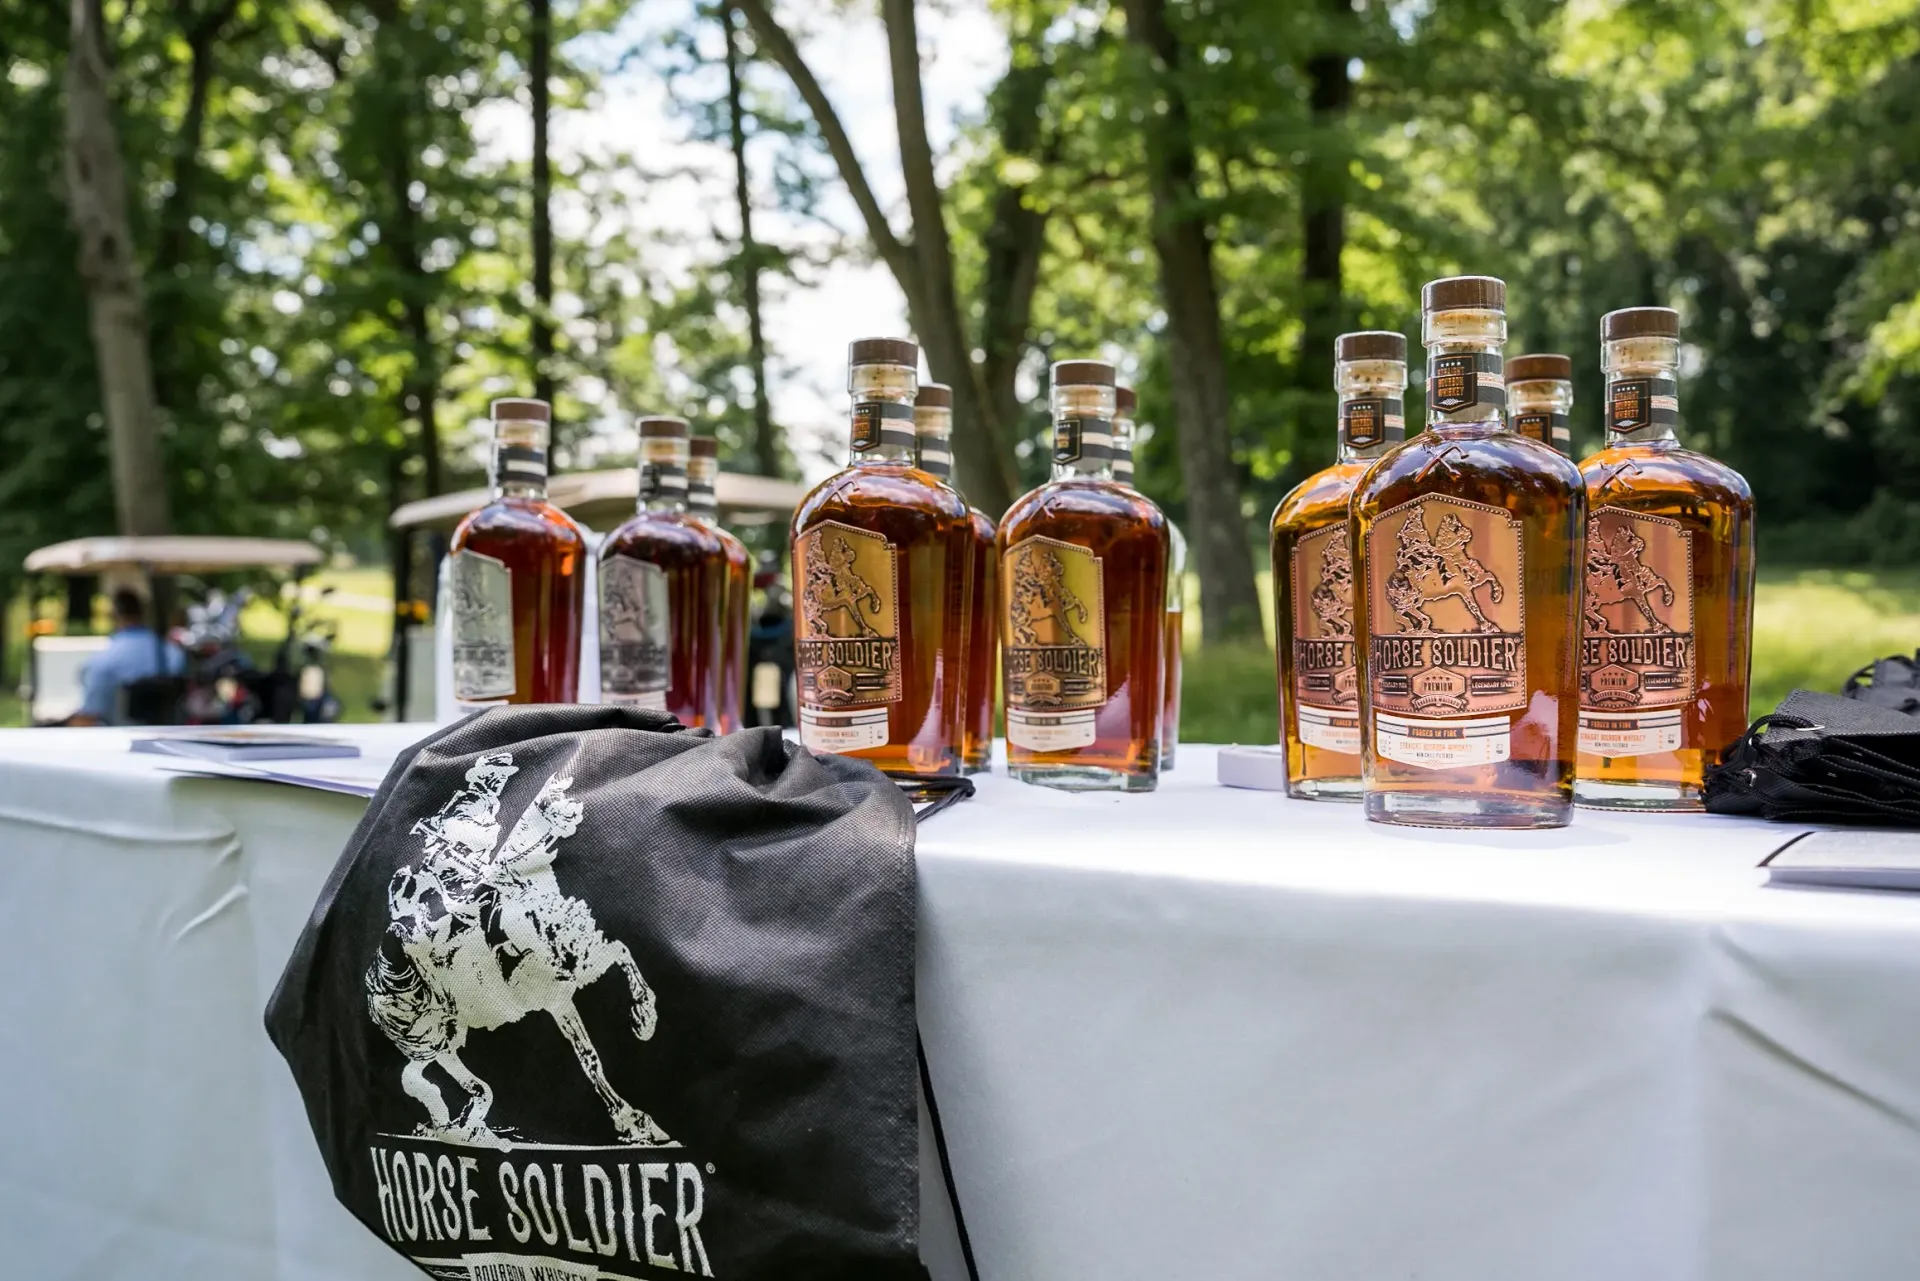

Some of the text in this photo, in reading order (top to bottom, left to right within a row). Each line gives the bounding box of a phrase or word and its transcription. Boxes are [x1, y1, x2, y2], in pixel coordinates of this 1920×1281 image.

[828, 642, 892, 670] SOLDIER
[1037, 650, 1098, 676] SOLDIER
[1299, 642, 1344, 671] HORSE
[1375, 639, 1423, 672] HORSE
[1432, 638, 1516, 671] SOLDIER
[1608, 638, 1686, 668] SOLDIER
[1424, 682, 1453, 691] PREMIUM
[370, 1146, 716, 1277] HORSE SOLDIER
